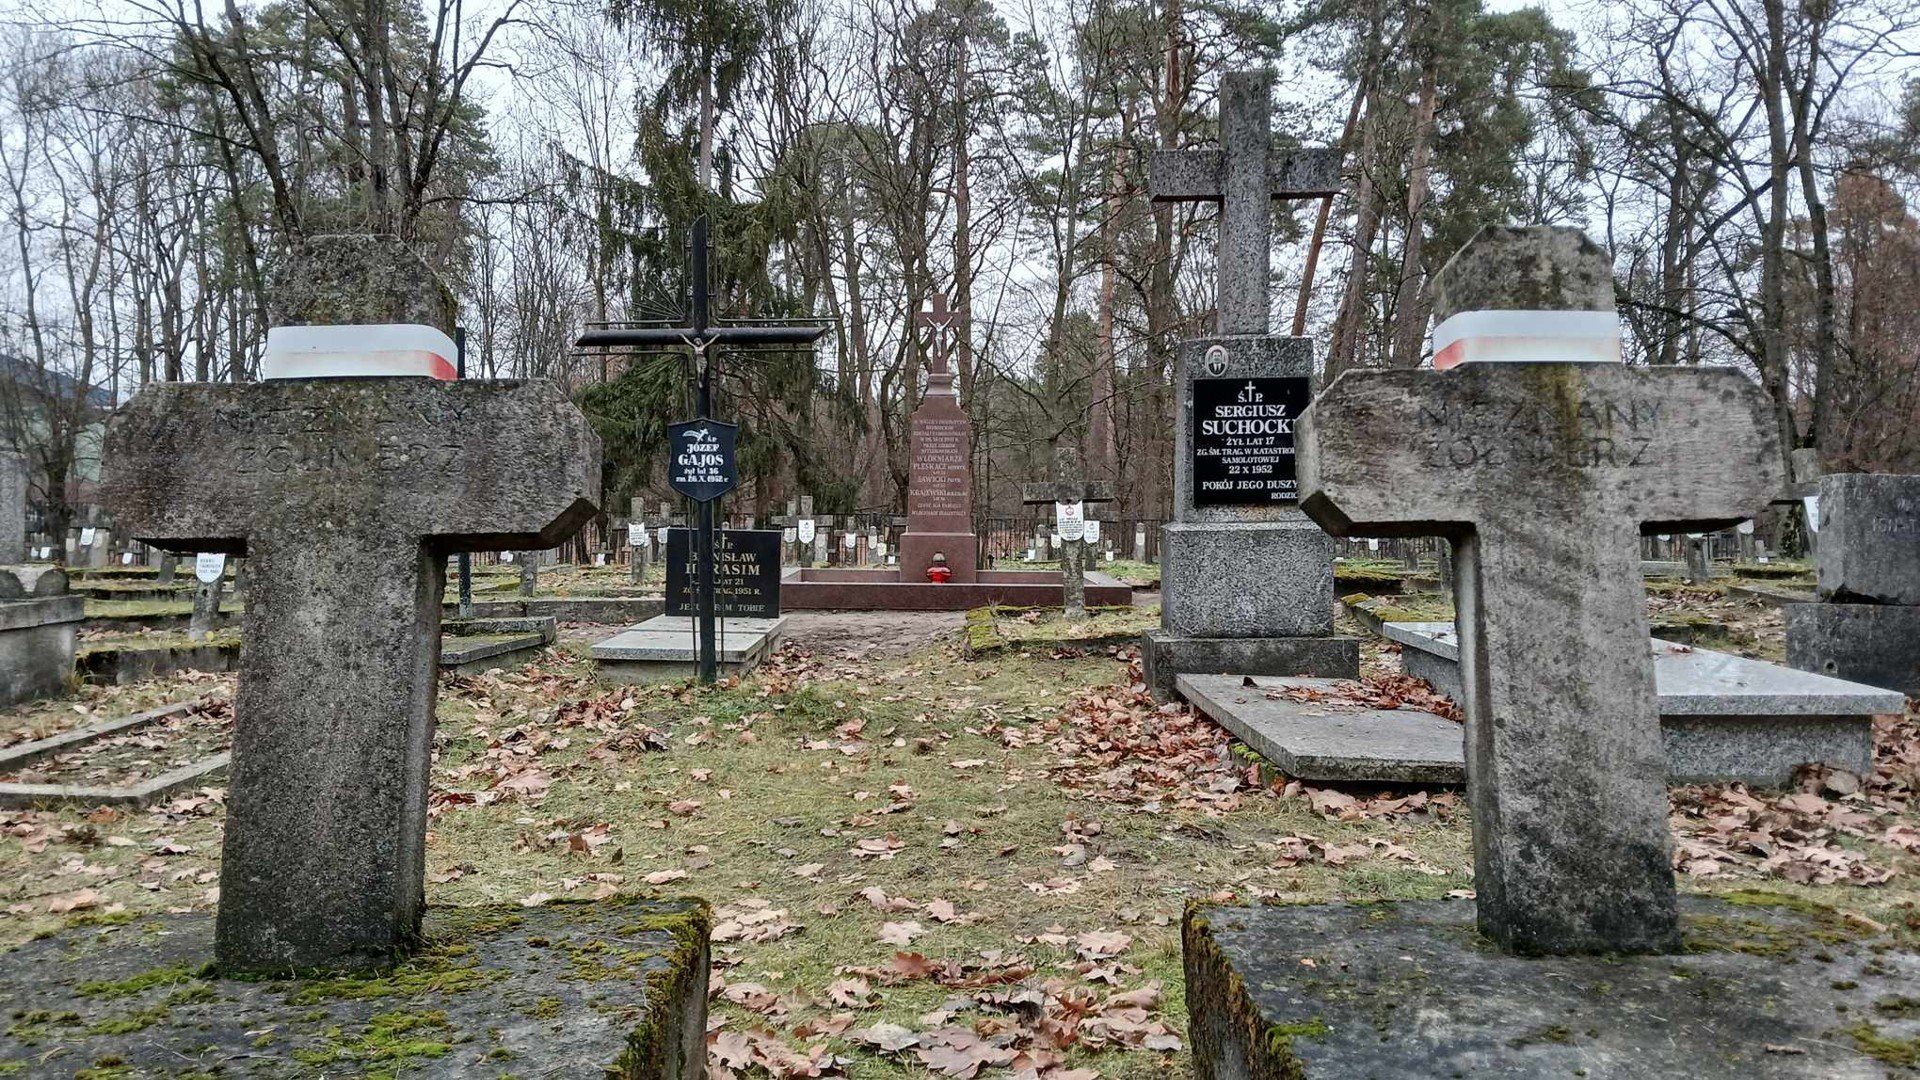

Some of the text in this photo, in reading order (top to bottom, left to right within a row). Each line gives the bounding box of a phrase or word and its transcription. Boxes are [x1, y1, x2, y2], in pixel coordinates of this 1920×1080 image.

[1215, 405, 1286, 418] SERGIUSZ
[1226, 437, 1275, 446] ŻYŁ LAT 17
[687, 444, 720, 454] JÓZEF
[678, 454, 724, 468] GAJOS
[1221, 456, 1280, 464] SAMOLOTOWEJ
[697, 467, 707, 475] lat
[1228, 465, 1240, 474] 22
[1252, 465, 1273, 474] 1952
[1202, 479, 1297, 490] POKÓJ JEGO DUSZY
[685, 563, 761, 576] HRASIM
[738, 604, 765, 612] TOBIE
